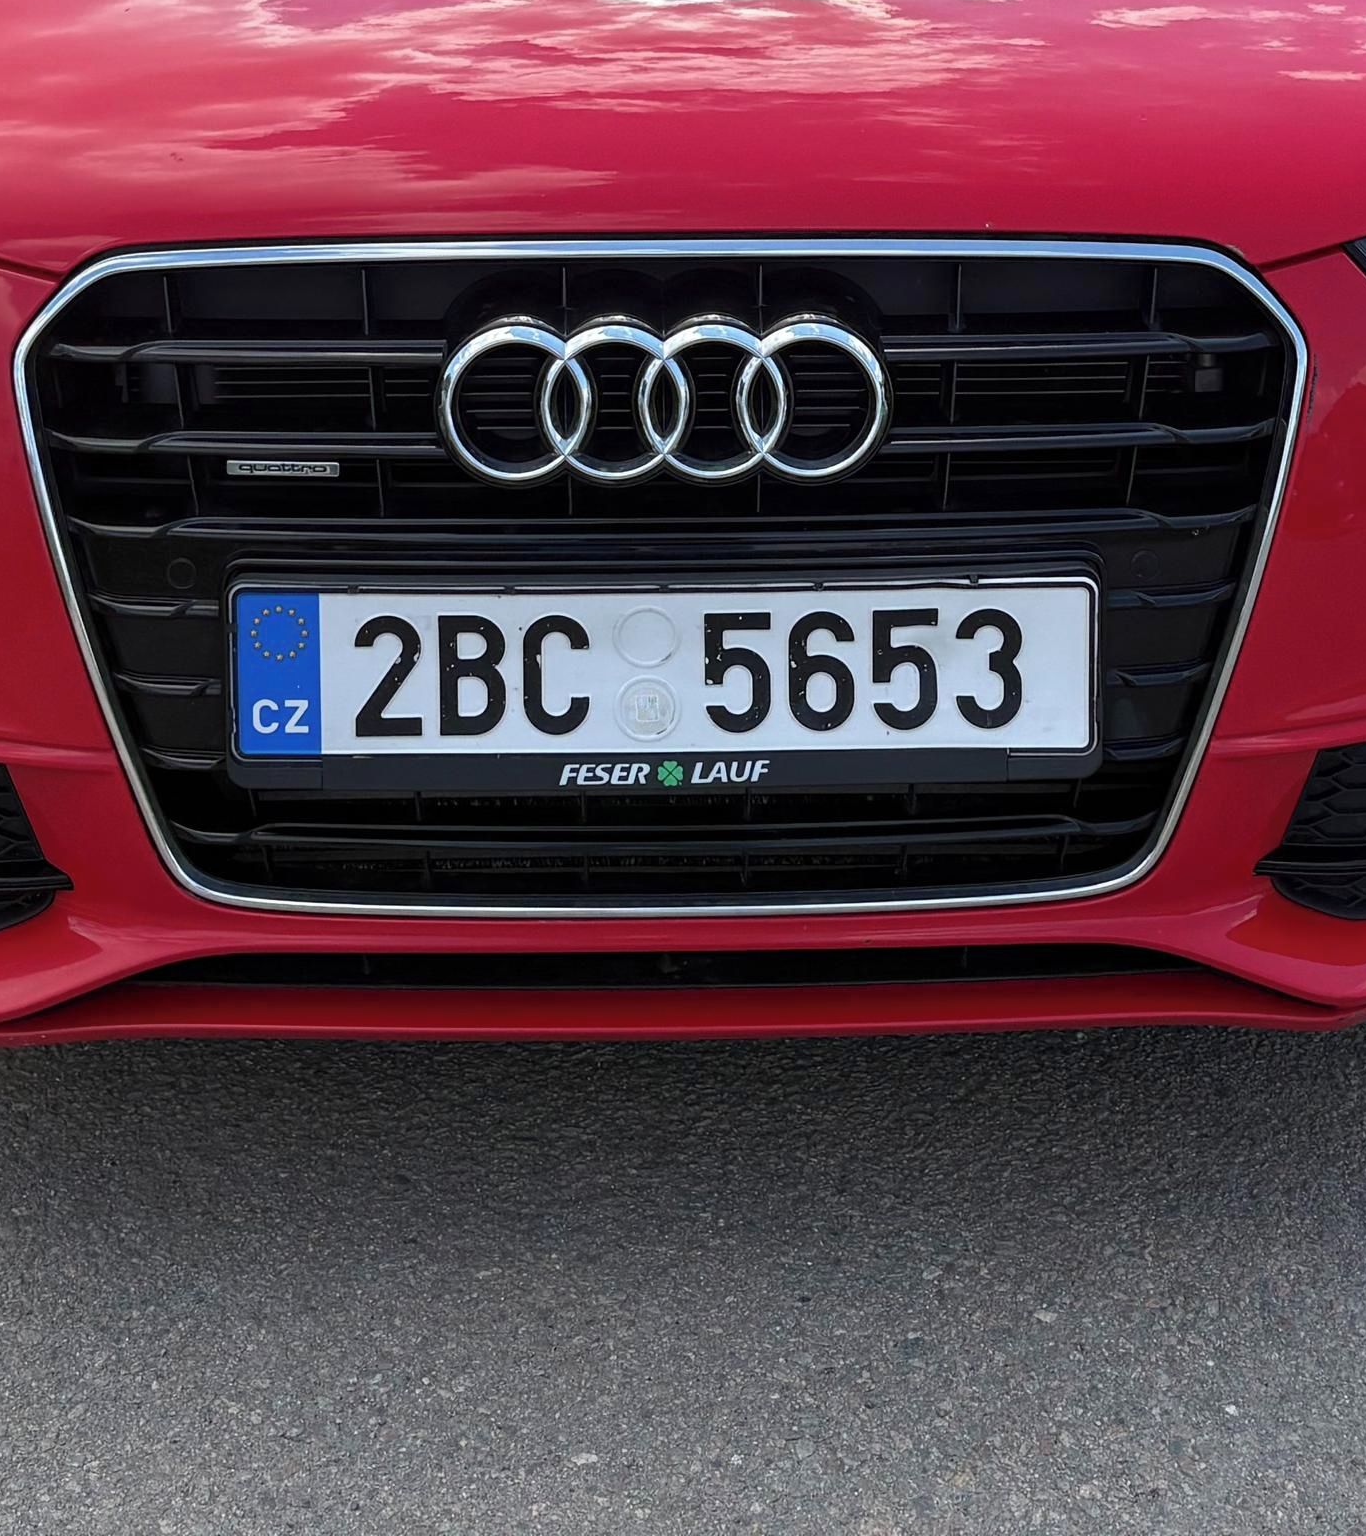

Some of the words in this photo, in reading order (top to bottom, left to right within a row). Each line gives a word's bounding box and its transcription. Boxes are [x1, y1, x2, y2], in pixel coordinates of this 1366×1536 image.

[238, 463, 328, 474] quattro
[252, 699, 309, 734] CZ
[354, 614, 590, 737] 2BC
[704, 608, 1023, 733] 5653
[558, 762, 651, 786] FESER
[690, 760, 771, 784] LAUF
